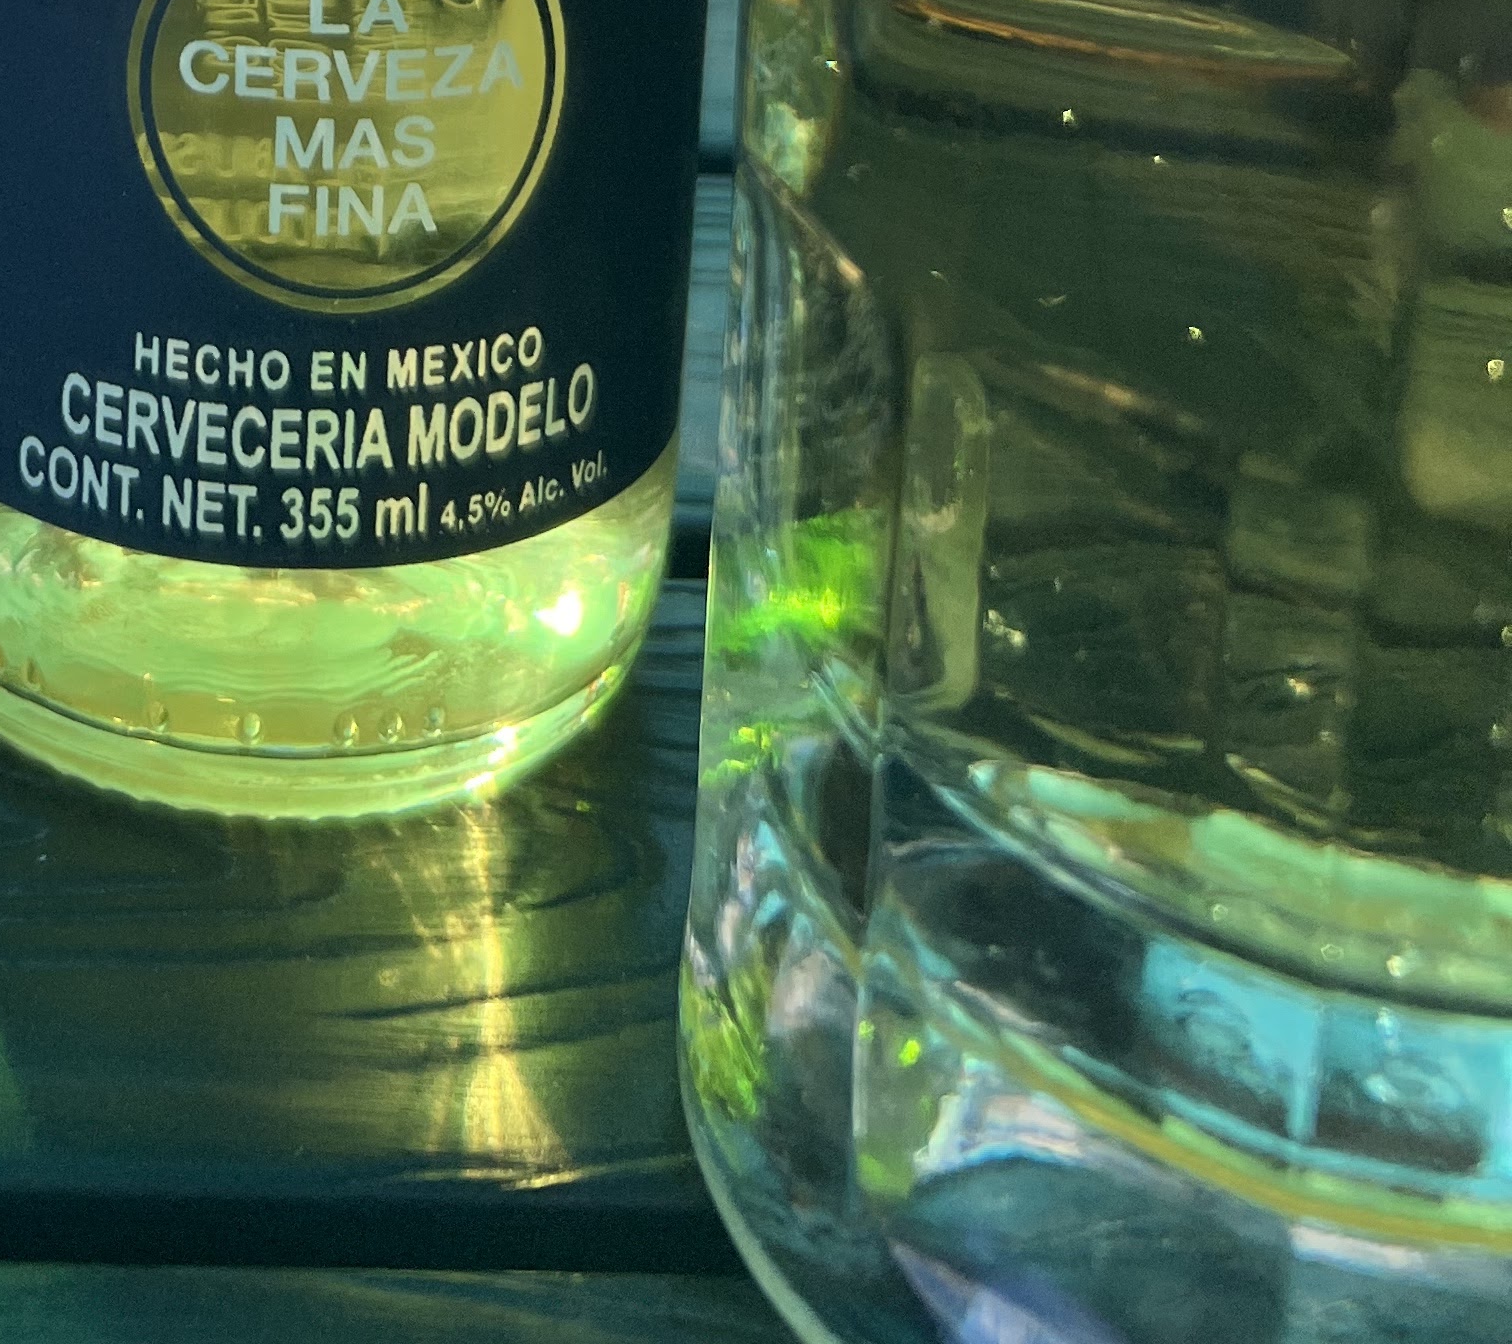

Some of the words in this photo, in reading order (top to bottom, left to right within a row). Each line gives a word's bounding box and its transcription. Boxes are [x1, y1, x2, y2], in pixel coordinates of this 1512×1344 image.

[178, 39, 524, 103] CERVEZA
[274, 115, 437, 171] MAS
[268, 182, 439, 237] FINA
[134, 330, 290, 390] HECHO
[309, 350, 367, 391] EN
[387, 325, 544, 389] MEXICO
[61, 371, 394, 471] CERVECERIA
[407, 362, 594, 467] MODELO
[18, 435, 145, 520] CONT.
[161, 473, 263, 539] NET.
[280, 486, 361, 540] 355
[374, 481, 430, 539] ml
[518, 474, 565, 513] Alc.
[571, 449, 609, 490] Vol.
